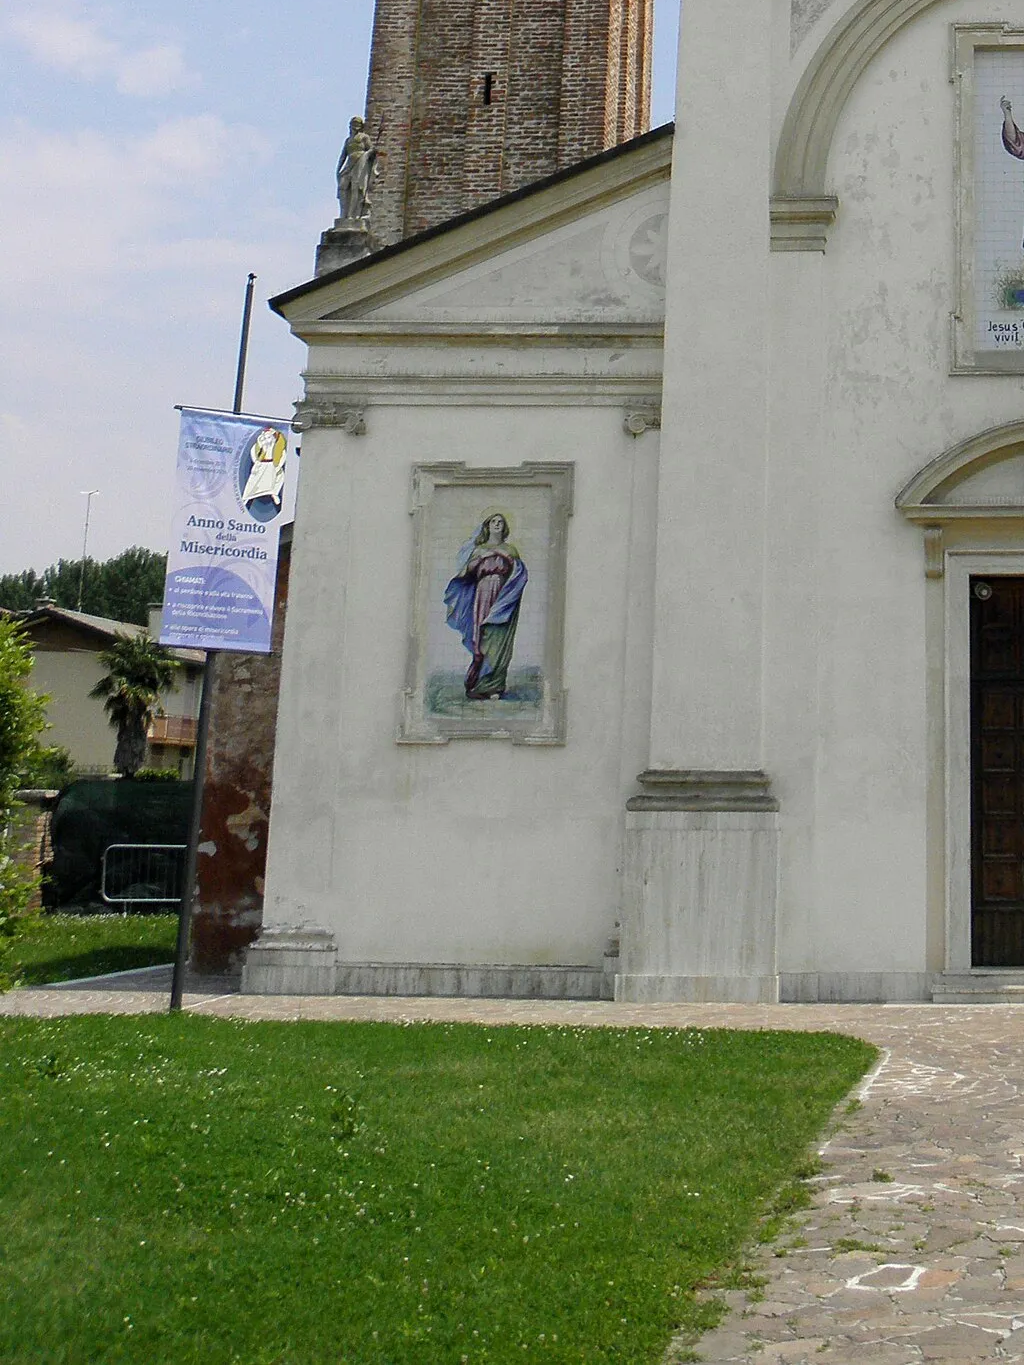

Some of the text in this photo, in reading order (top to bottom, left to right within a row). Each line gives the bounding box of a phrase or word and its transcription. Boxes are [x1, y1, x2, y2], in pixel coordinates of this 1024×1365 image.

[987, 320, 1018, 332] Jesus
[994, 331, 1019, 342] vivit
[186, 515, 266, 534] Anno Santo
[215, 532, 237, 542] della
[180, 541, 268, 560] Misericordia
